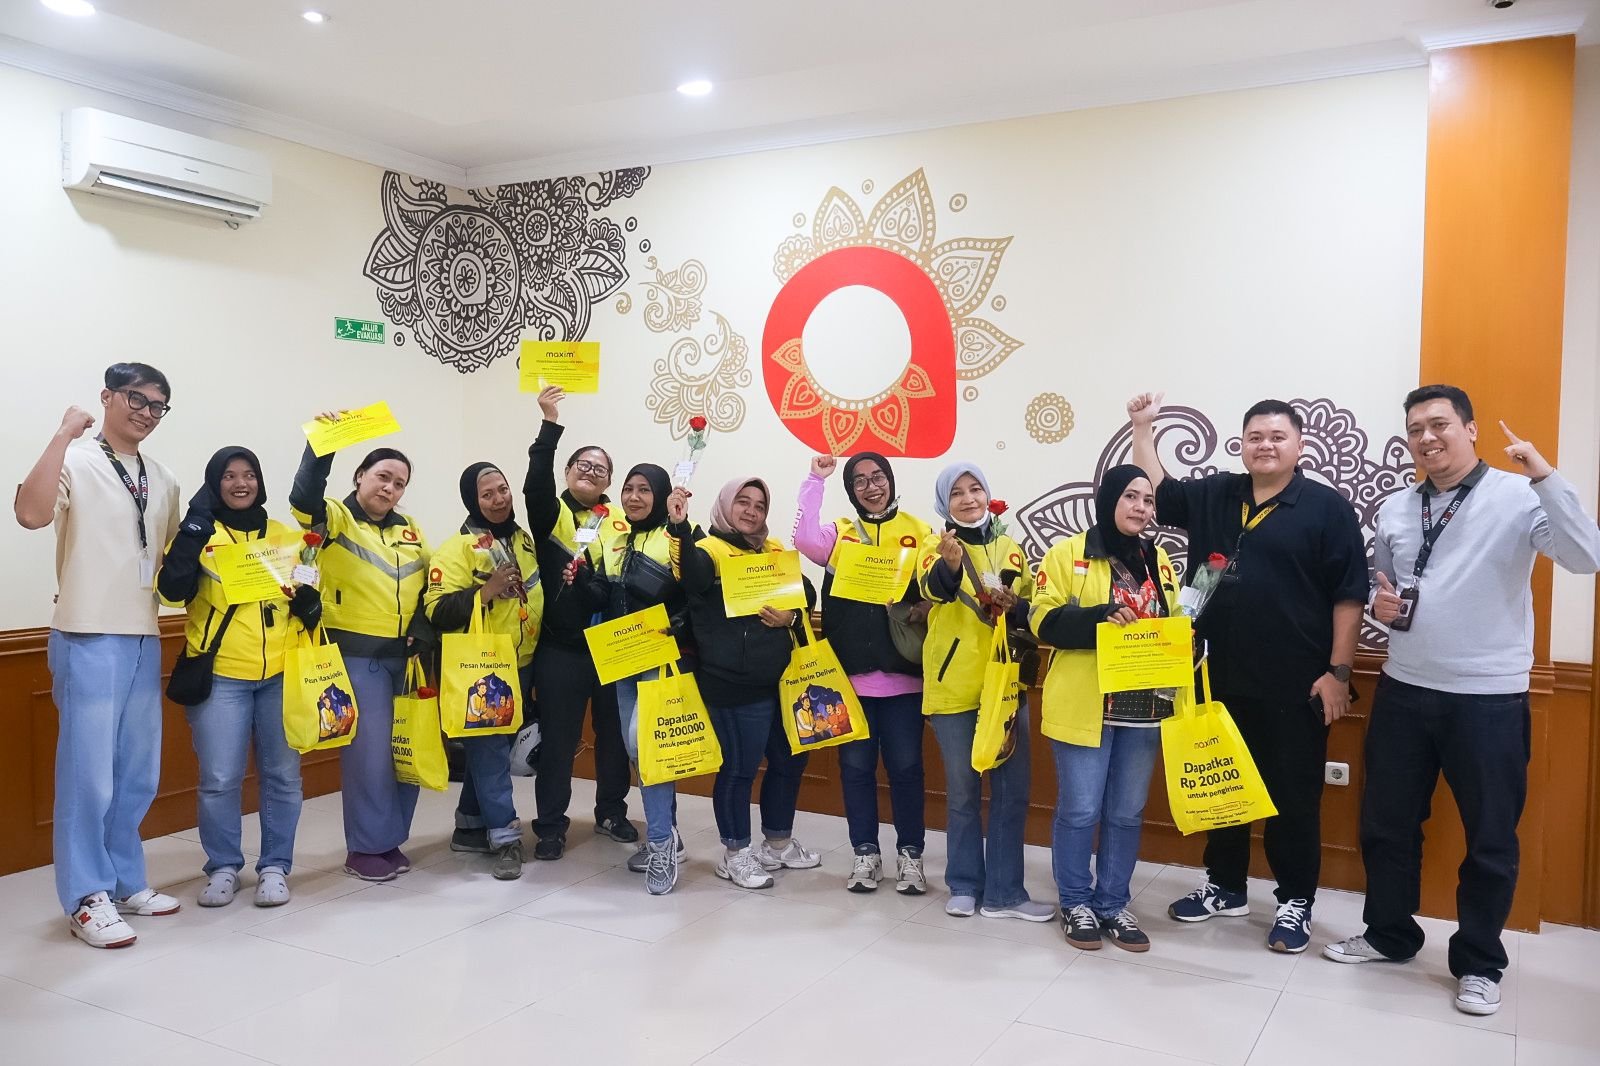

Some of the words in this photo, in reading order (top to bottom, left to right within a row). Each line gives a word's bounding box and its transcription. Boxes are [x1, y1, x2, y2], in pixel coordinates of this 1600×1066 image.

[361, 323, 379, 332] JALUR
[356, 330, 383, 341] EVAKUASI
[1422, 506, 1431, 531] maxim
[1440, 500, 1461, 526] maxim
[245, 548, 279, 561] maxim
[865, 556, 894, 565] maxim
[746, 563, 775, 573] maxim
[613, 622, 643, 637] maxim
[1123, 630, 1159, 640] maxim
[657, 712, 698, 727] Dapatan
[654, 729, 667, 740] Rp
[668, 721, 706, 738] 200.000
[658, 741, 676, 749] untuk
[1180, 777, 1197, 790] Rp
[1198, 768, 1240, 787] 200.00
[1187, 791, 1208, 799] untuk
